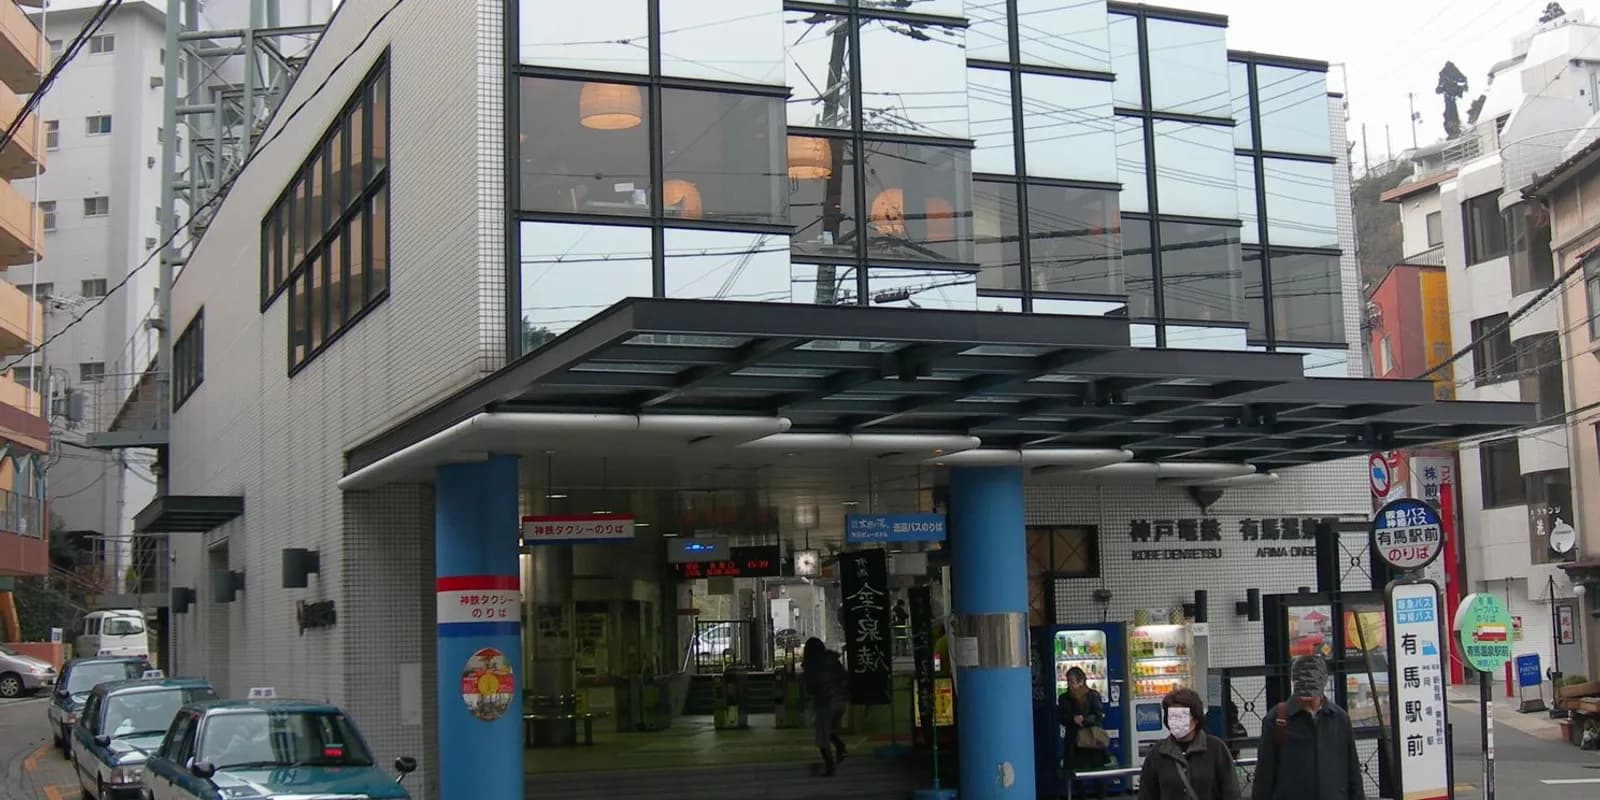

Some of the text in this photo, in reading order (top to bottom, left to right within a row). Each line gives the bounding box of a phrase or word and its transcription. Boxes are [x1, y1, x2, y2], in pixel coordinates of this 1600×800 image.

[1439, 465, 1450, 482] コン
[1424, 466, 1437, 501] 株前
[1385, 508, 1427, 519] 阪急バス
[535, 525, 624, 536] 神鉄タクシーのりば
[1377, 528, 1438, 546] 有馬駅前
[1132, 550, 1163, 561] KOBE
[1256, 547, 1288, 558] ARIMA
[1291, 546, 1317, 557] ONSE
[1388, 547, 1429, 561] のりば
[460, 595, 514, 606] 神鉄タクシー
[472, 608, 507, 618] のりば
[1467, 645, 1509, 657] 有馬温泉駅前
[1400, 632, 1424, 758] 有馬駅前
